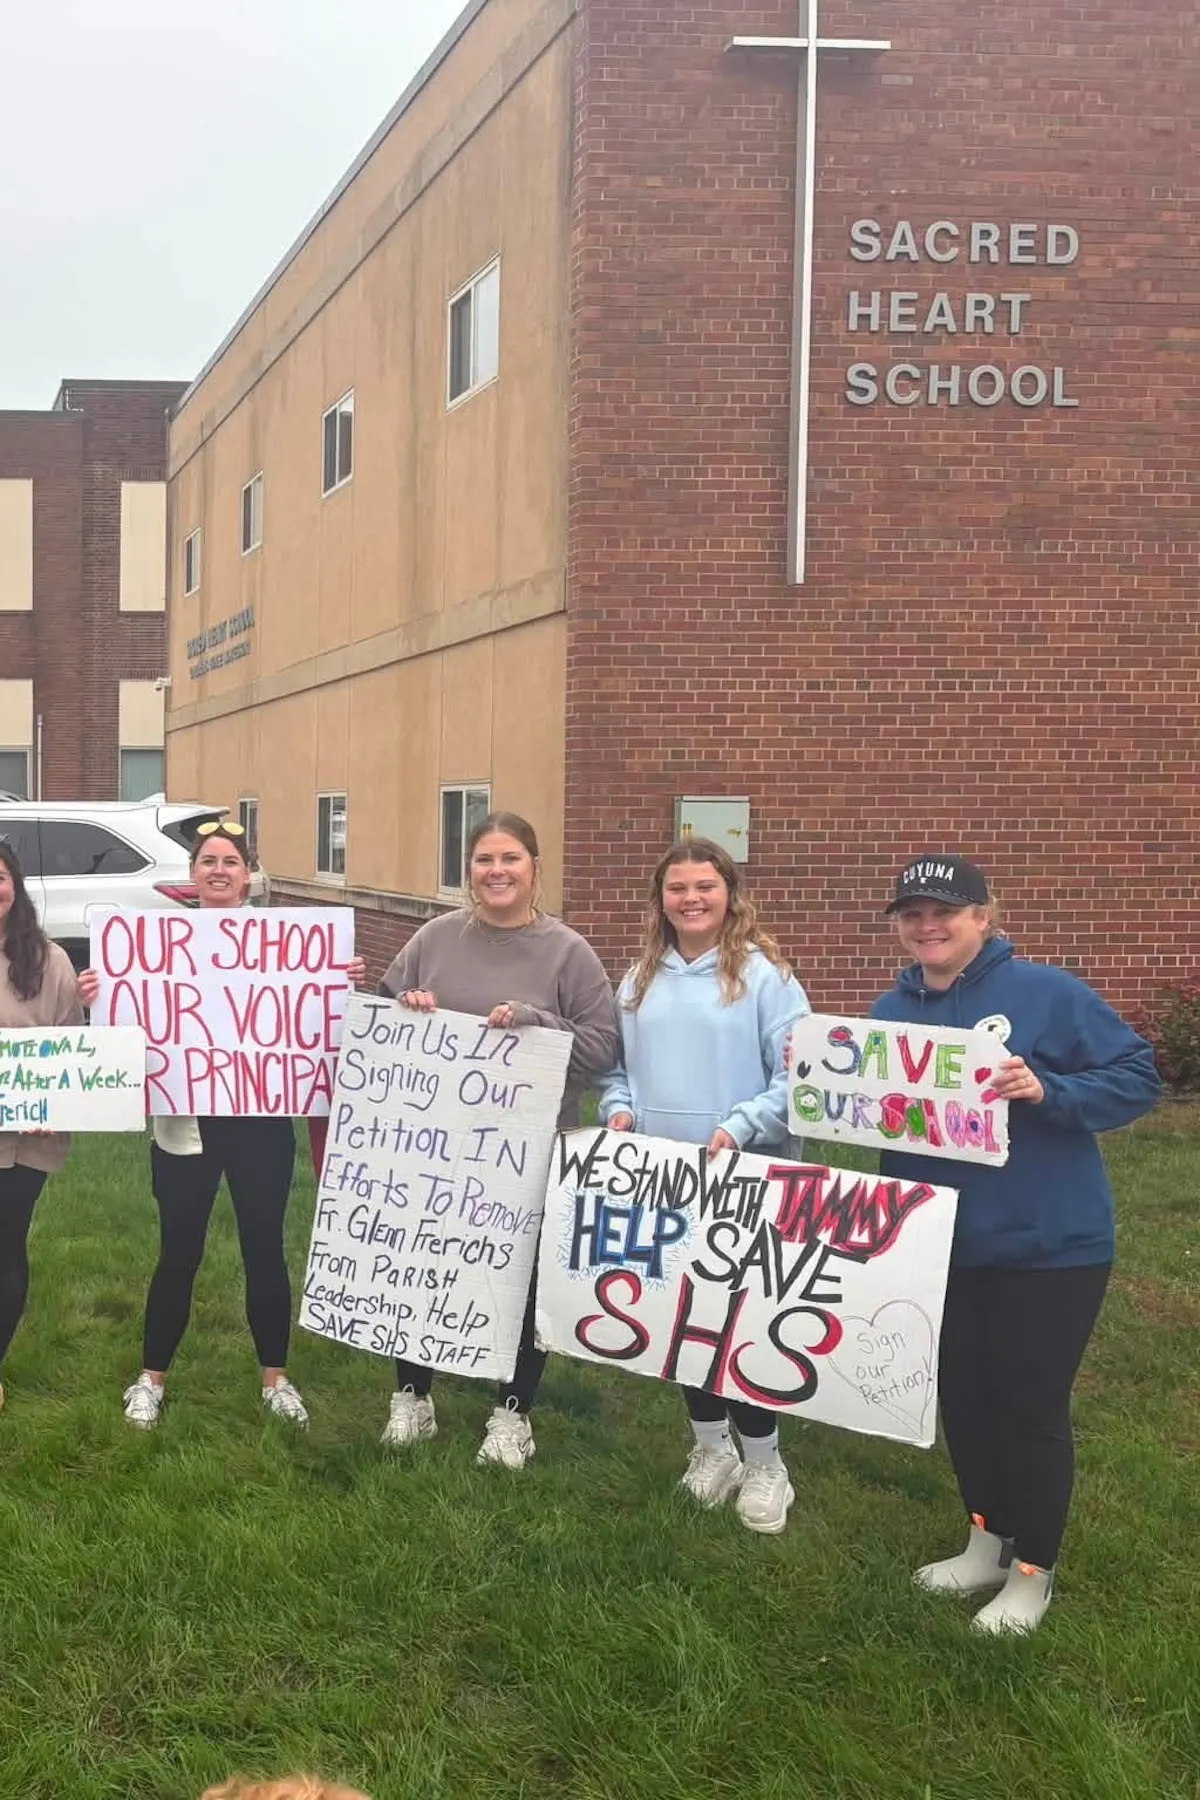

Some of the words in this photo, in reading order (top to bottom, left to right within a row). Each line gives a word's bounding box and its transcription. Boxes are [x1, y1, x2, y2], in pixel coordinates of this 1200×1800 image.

[850, 218, 1079, 265] SACRED
[848, 290, 1031, 333] HEART
[845, 362, 1079, 407] SCHOOL
[102, 915, 197, 978] OUR
[211, 918, 350, 974] SCHOOL
[109, 979, 214, 1046] OUR
[223, 983, 348, 1052] VOICE
[350, 1002, 415, 1046] Join
[421, 1018, 459, 1062] Us
[463, 1022, 520, 1067] In
[10, 1062, 57, 1091] After
[57, 1068, 71, 1090] A
[77, 1065, 142, 1092] Week...
[337, 1048, 441, 1111] Signing
[459, 1069, 533, 1110] Our
[821, 1025, 967, 1089] SAVE
[792, 1083, 874, 1129] OUR
[333, 1103, 451, 1162] Petition
[464, 1127, 527, 1177] IN
[321, 1153, 409, 1208] Efforts
[418, 1172, 456, 1216] To
[558, 1131, 611, 1190] WE
[699, 1146, 770, 1233] WITH
[766, 1164, 936, 1258] TAMMY
[309, 1241, 357, 1281] From
[316, 1198, 342, 1232] Fr.
[411, 1218, 514, 1271] Frerichs
[568, 1193, 690, 1279] HELP
[691, 1218, 870, 1304] SAVE
[305, 1303, 371, 1344] SAVE
[369, 1323, 409, 1359] SHS
[418, 1334, 492, 1368] STAFF
[426, 1293, 490, 1338] Help
[574, 1268, 844, 1406] SHS
[856, 1331, 906, 1362] Sign
[856, 1363, 891, 1380] our
